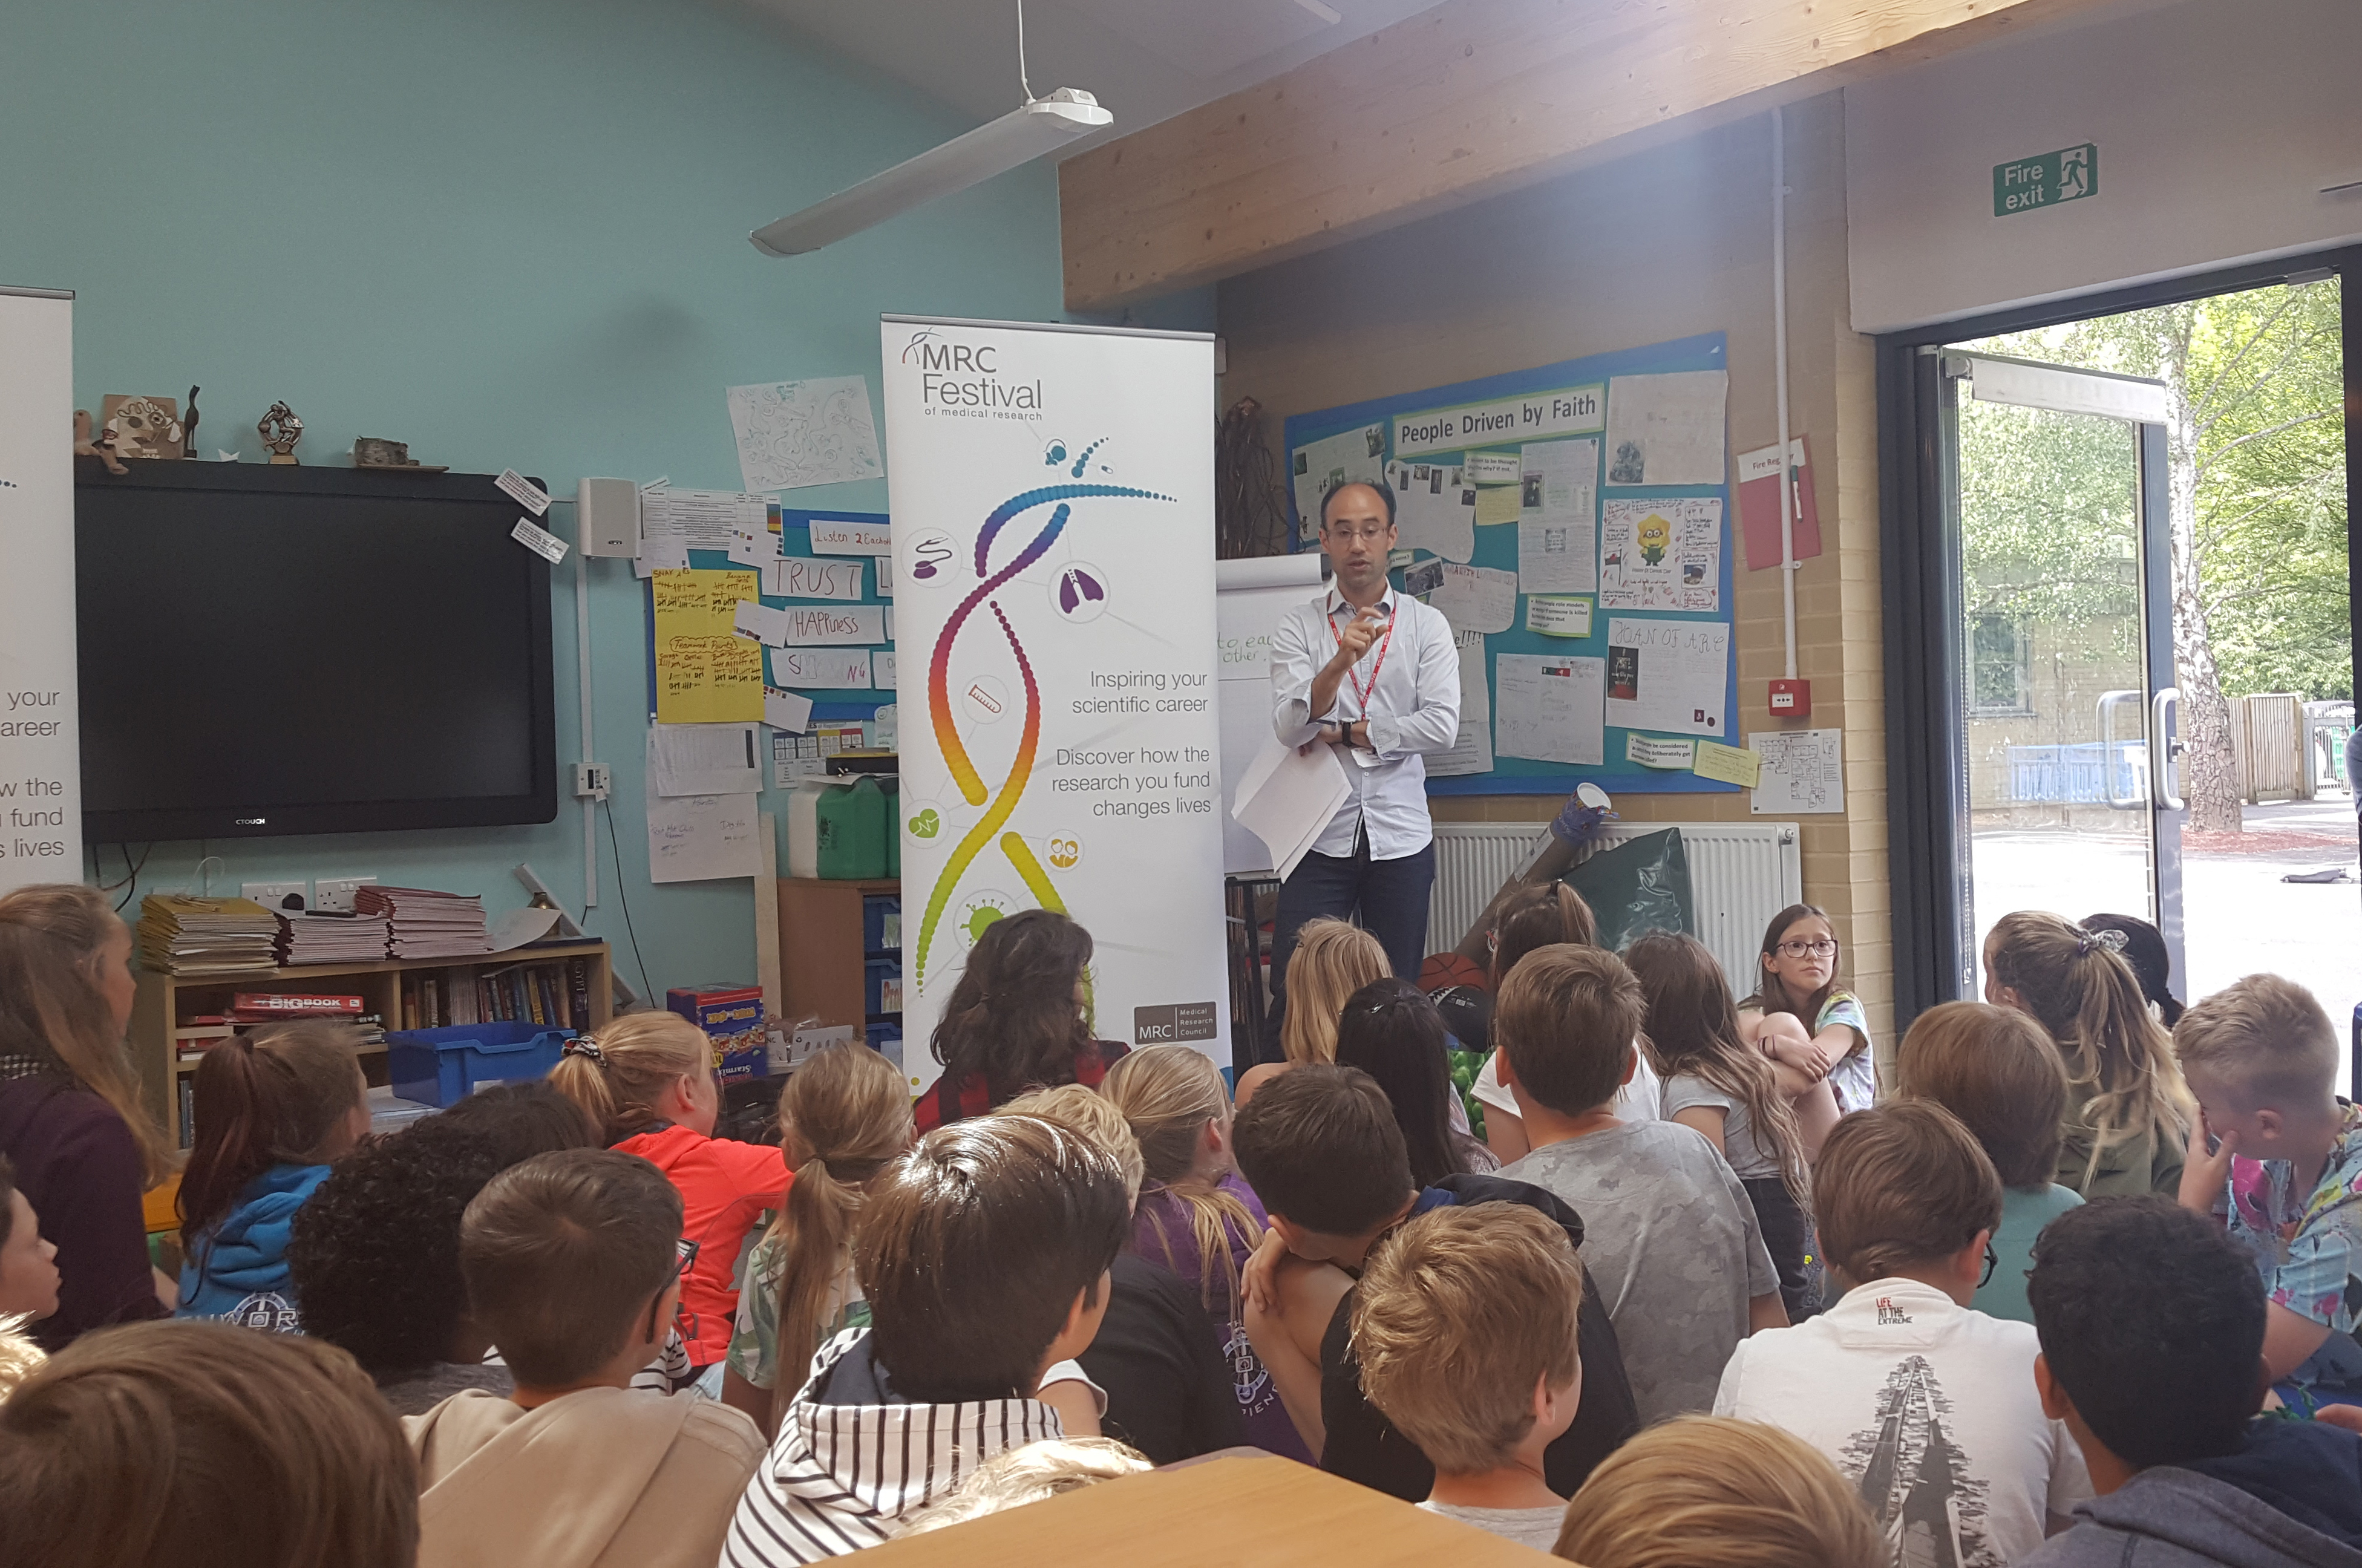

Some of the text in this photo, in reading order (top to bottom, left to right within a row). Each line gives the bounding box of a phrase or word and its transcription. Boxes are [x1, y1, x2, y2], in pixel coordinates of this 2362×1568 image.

[2004, 164, 2043, 186] Fire
[2006, 185, 2044, 209] exit
[923, 343, 996, 373] MRC
[923, 373, 1042, 409] Festival
[924, 407, 1042, 420] of medical research
[1402, 394, 1595, 443] People Driven by Faith
[1753, 461, 1766, 470] Fire
[814, 526, 848, 542] Listen
[773, 560, 862, 596] TRUST
[1217, 632, 1272, 649] to eac
[1661, 629, 1681, 648] OF
[1091, 670, 1208, 690] Inspiring your
[7, 691, 60, 711] your
[1072, 696, 1208, 713] scientific career
[0, 722, 61, 736] areer
[1057, 746, 1209, 765] Discover how the
[25, 777, 62, 796] the
[1052, 771, 1210, 793] research you fund
[10, 807, 63, 827] fund
[1093, 797, 1211, 818] changes lives
[15, 838, 64, 857] lives
[269, 999, 303, 1009] BIG
[1139, 1024, 1172, 1039] MRC
[1876, 1297, 1892, 1308] LIFE
[1878, 1316, 1913, 1325] EXTREME
[1879, 1307, 1904, 1318] AT THE
